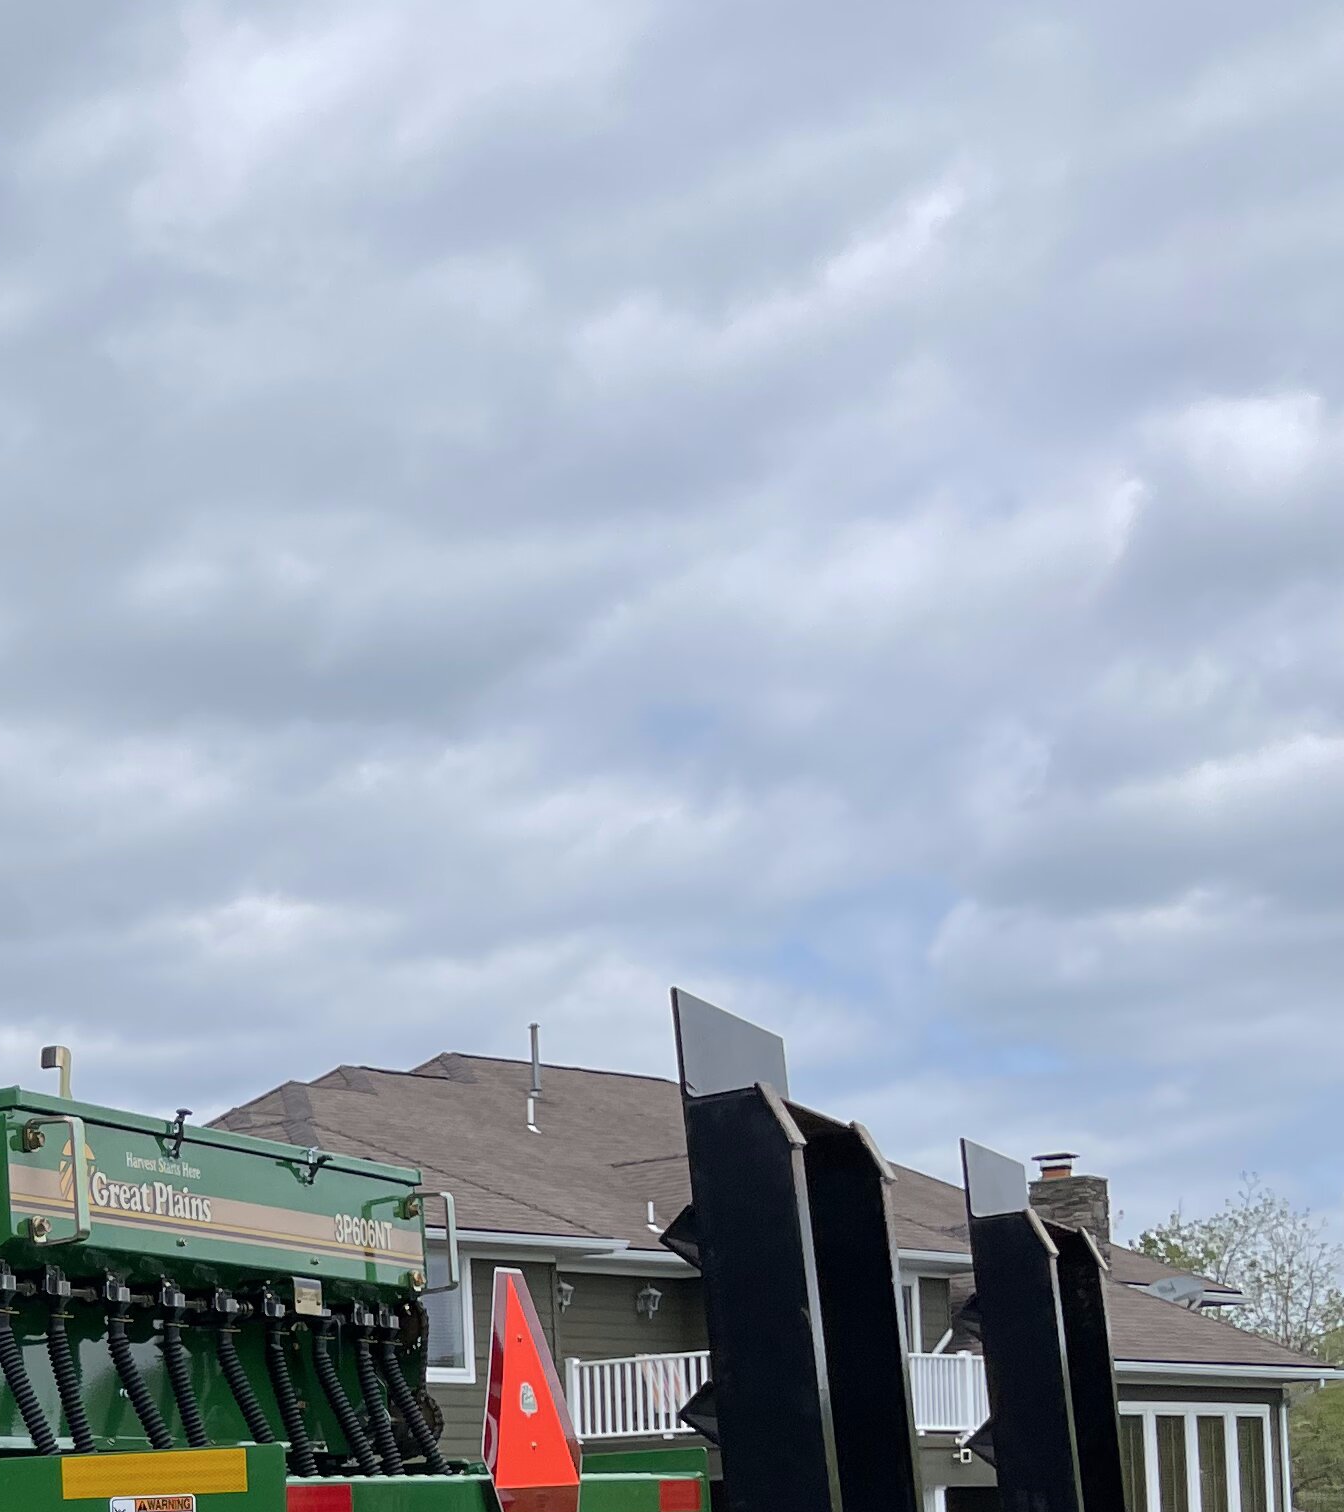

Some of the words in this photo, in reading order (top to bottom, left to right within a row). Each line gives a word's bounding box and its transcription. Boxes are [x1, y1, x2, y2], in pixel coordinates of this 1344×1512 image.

[125, 1151, 157, 1173] Harvest
[158, 1157, 181, 1177] Starts
[182, 1162, 201, 1180] Here
[91, 1171, 152, 1213] Great
[153, 1181, 212, 1223] Plains
[334, 1213, 393, 1250] 3P606NT
[147, 1498, 191, 1510] WARNING
